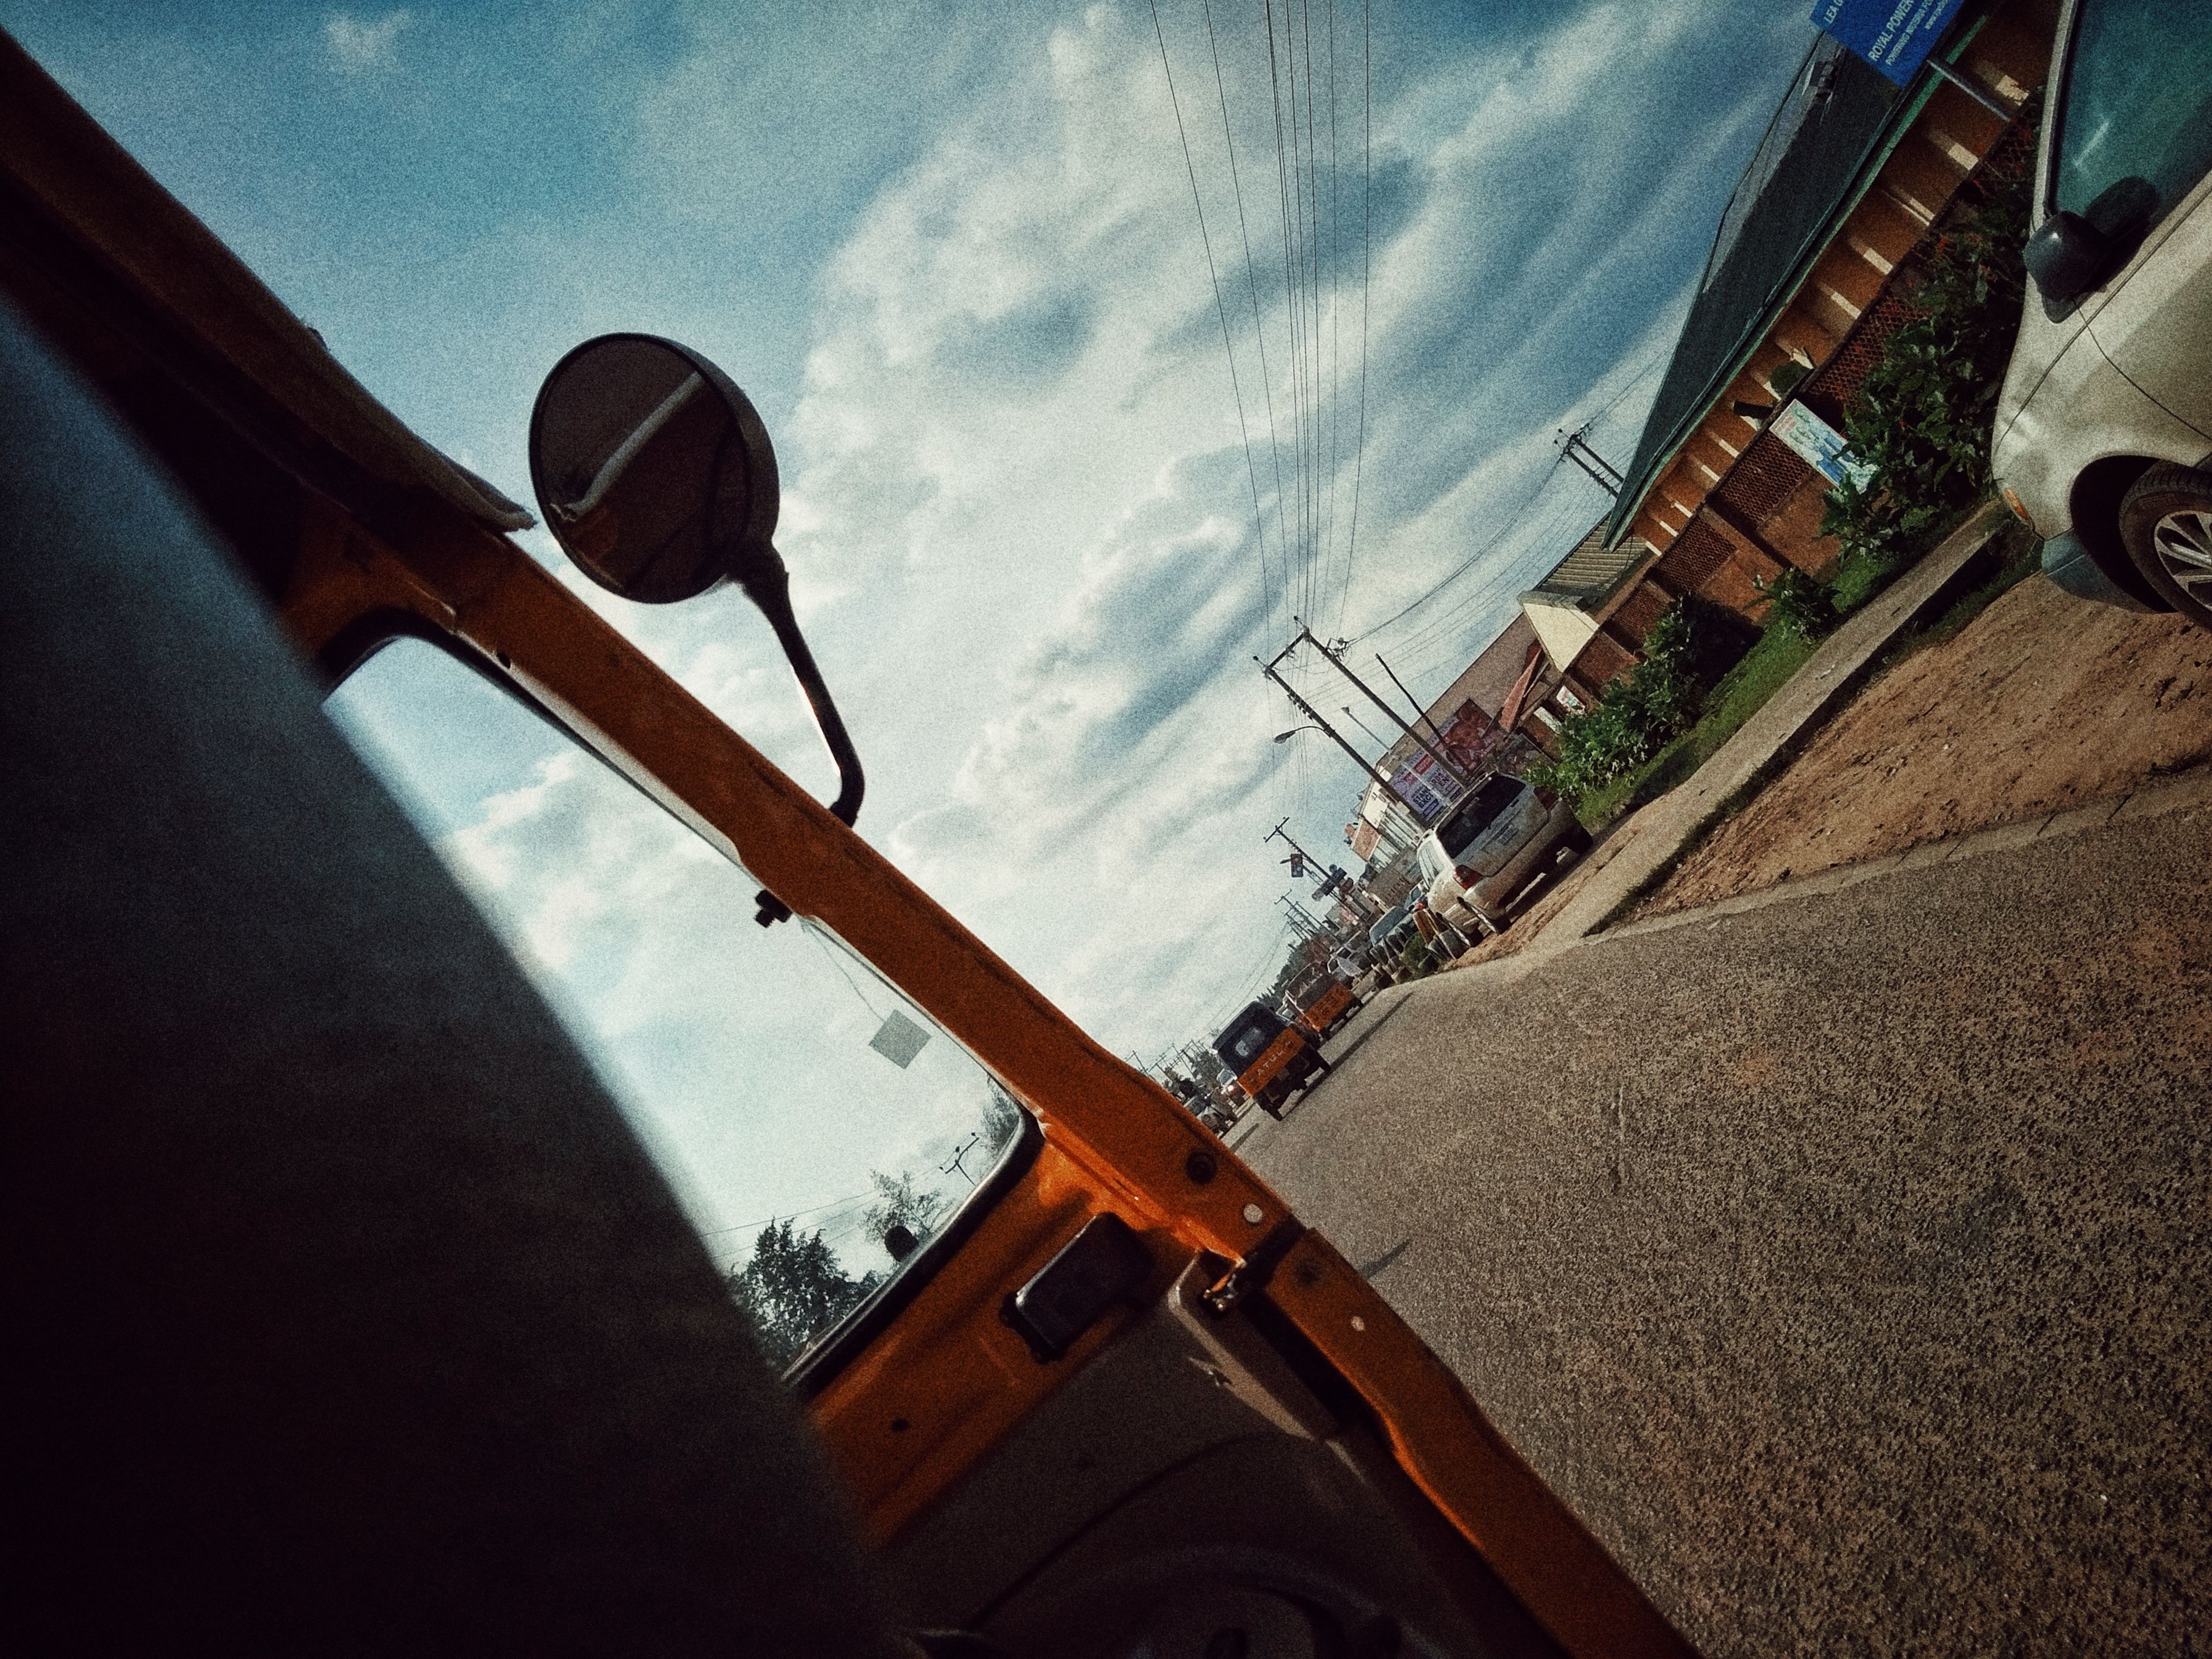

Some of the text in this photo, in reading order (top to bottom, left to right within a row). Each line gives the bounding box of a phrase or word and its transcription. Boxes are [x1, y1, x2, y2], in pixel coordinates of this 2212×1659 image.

[1823, 5, 1839, 24] LEA
[1867, 31, 1893, 61] ROYAL
[1886, 32, 1910, 65] POWERING
[1258, 1051, 1283, 1076] ATUL
